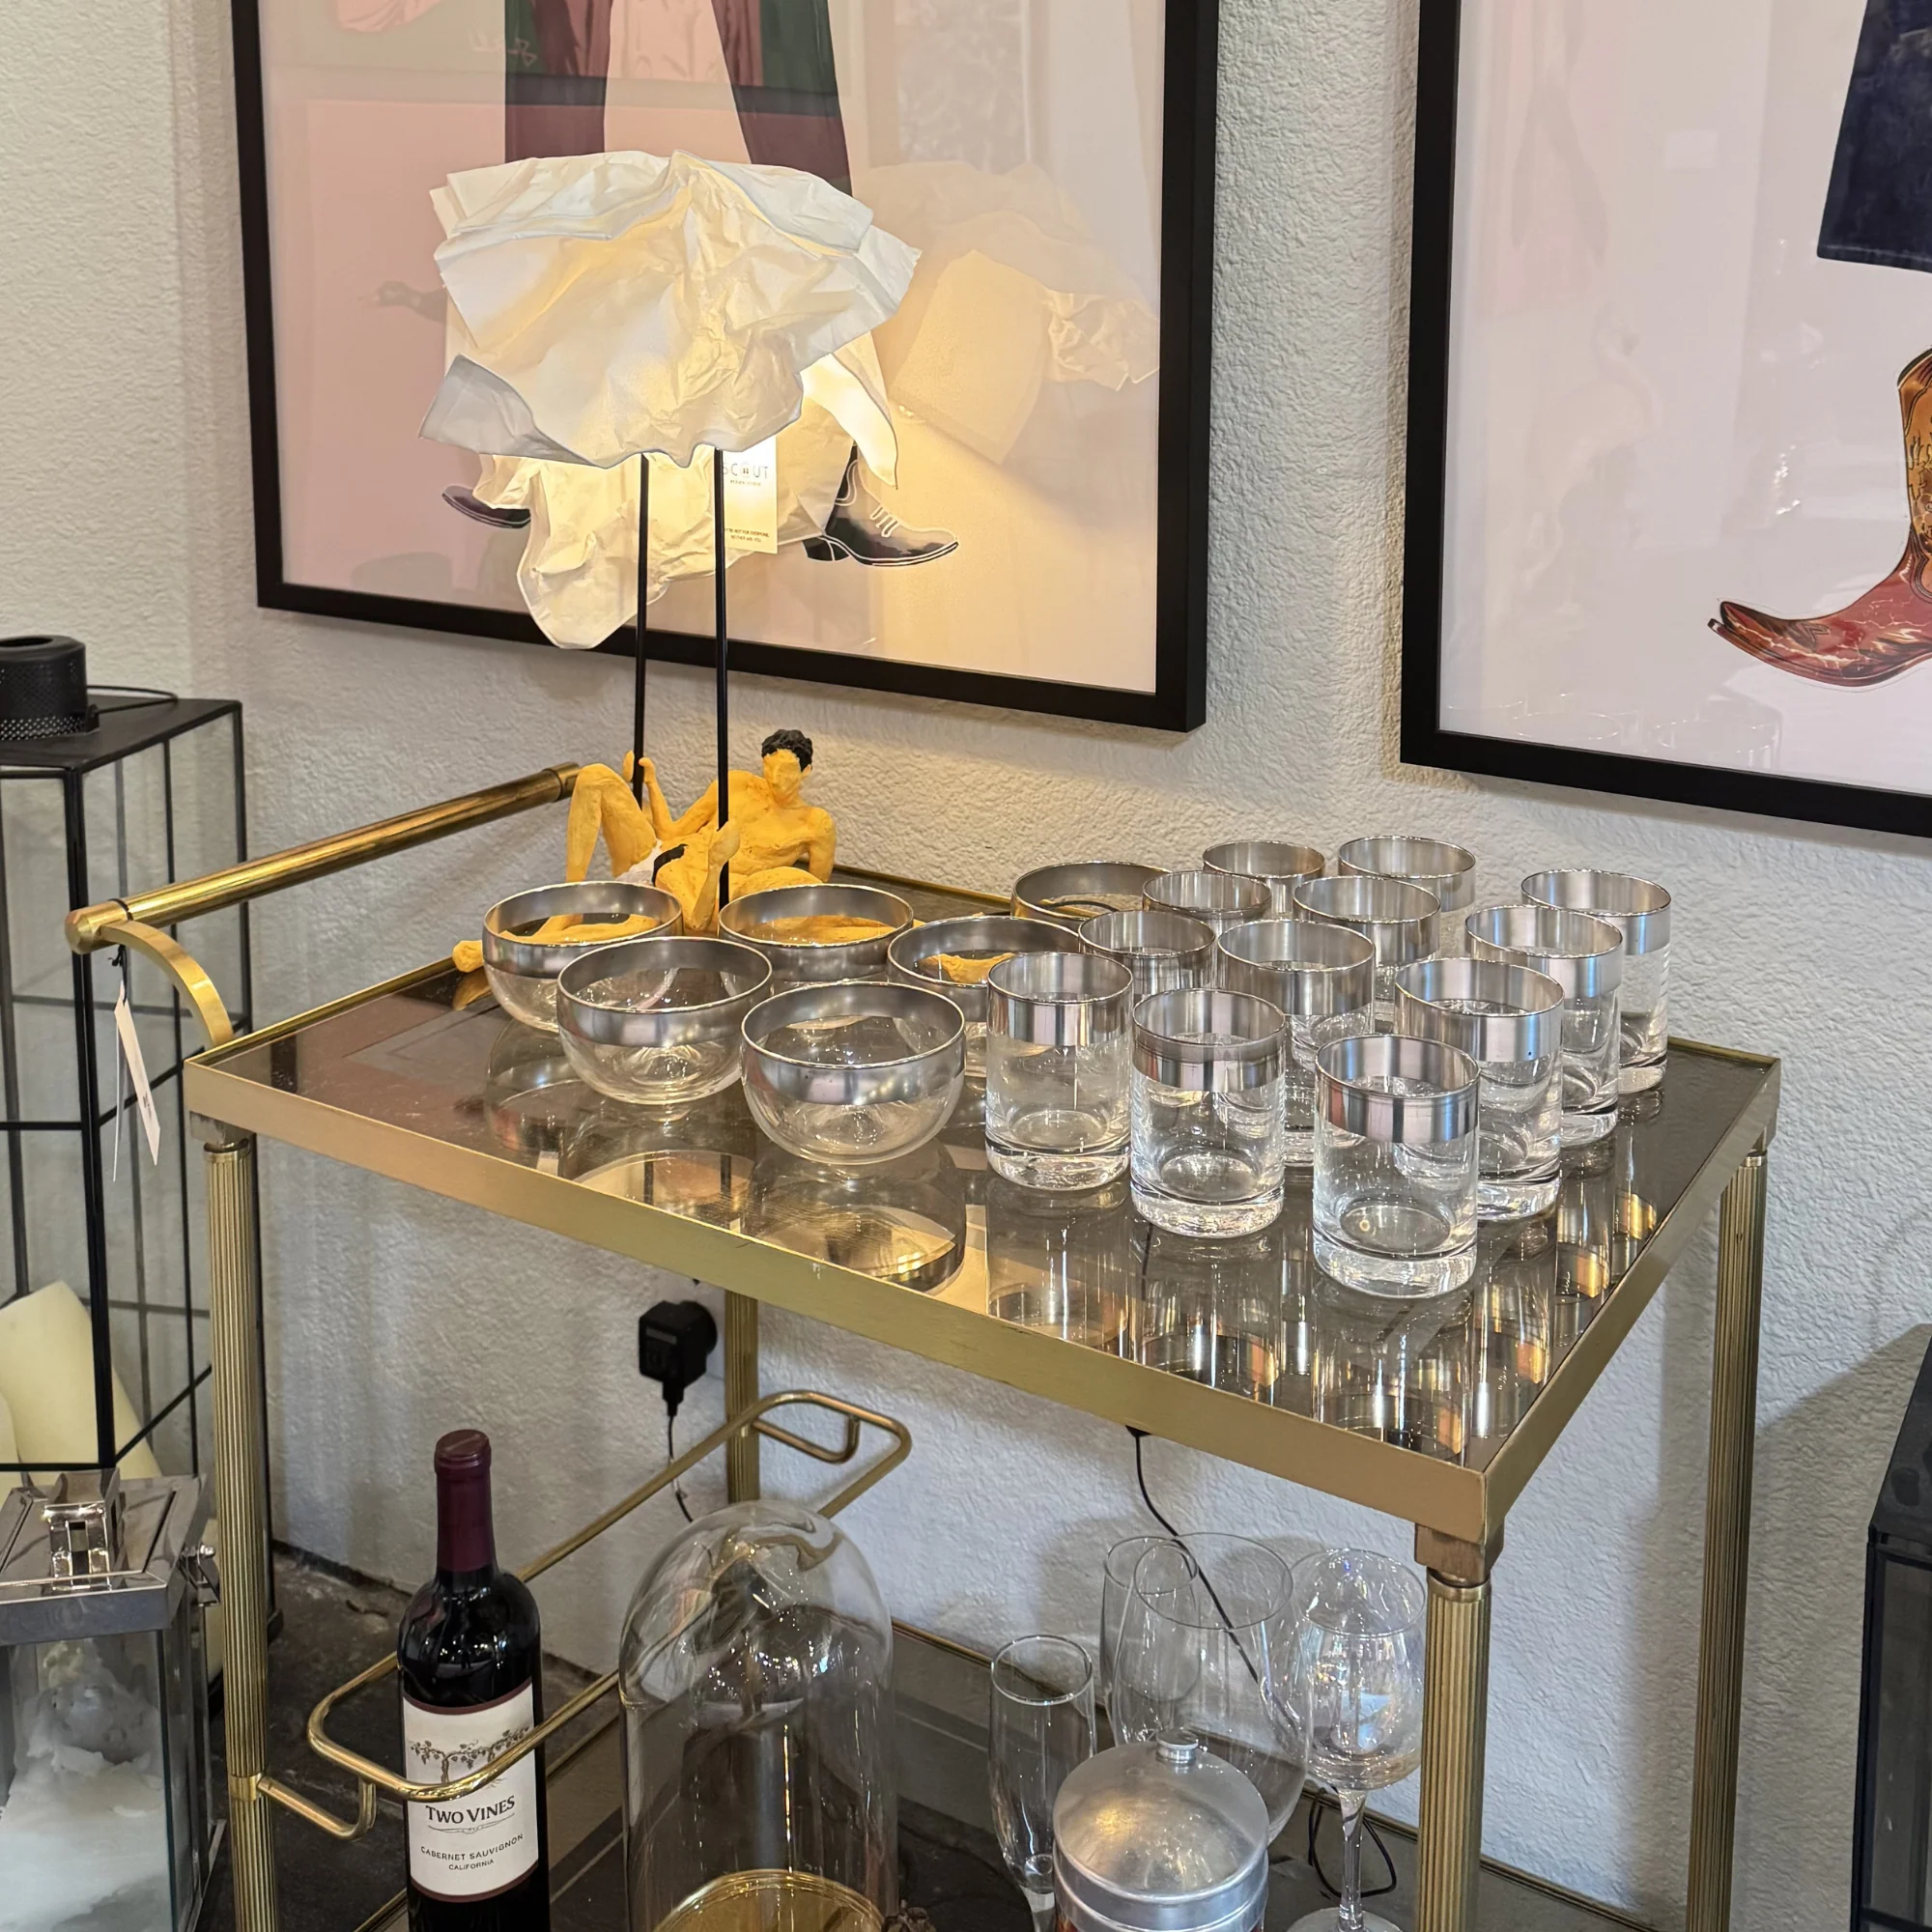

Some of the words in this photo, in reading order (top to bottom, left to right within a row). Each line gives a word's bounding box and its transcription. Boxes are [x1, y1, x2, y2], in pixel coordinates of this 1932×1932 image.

[425, 1804, 464, 1824] TWO
[466, 1795, 516, 1823] VINES
[420, 1846, 466, 1861] CABERNET
[469, 1833, 524, 1860] SAUVIGNON
[448, 1859, 495, 1870] CALIFORNIA
